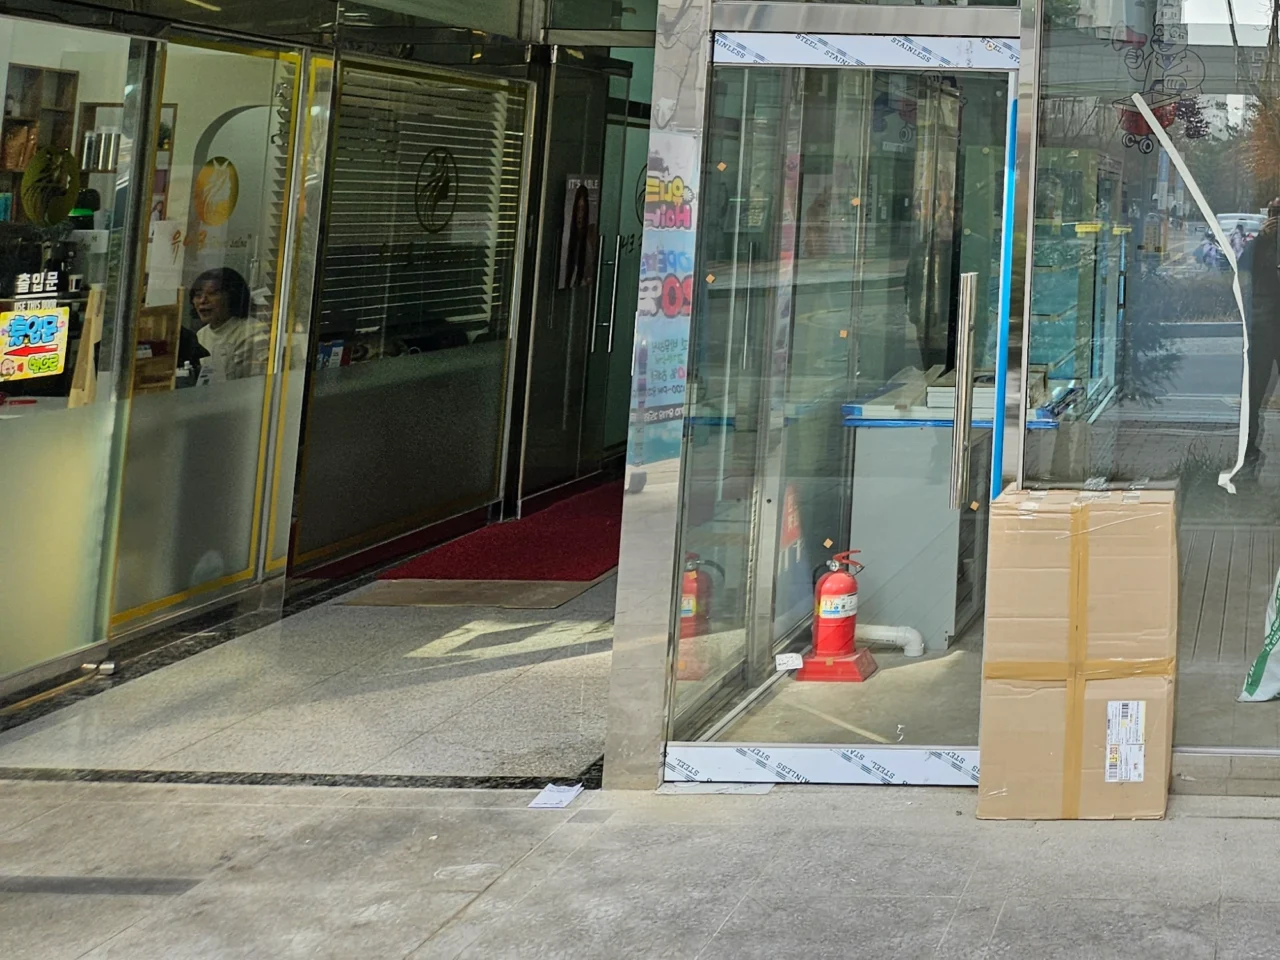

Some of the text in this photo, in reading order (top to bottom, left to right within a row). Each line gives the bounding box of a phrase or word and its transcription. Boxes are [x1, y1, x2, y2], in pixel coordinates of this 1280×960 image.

[891, 37, 932, 63] STAINLESS
[16, 271, 58, 293] 출입문
[8, 315, 59, 347] 출입문
